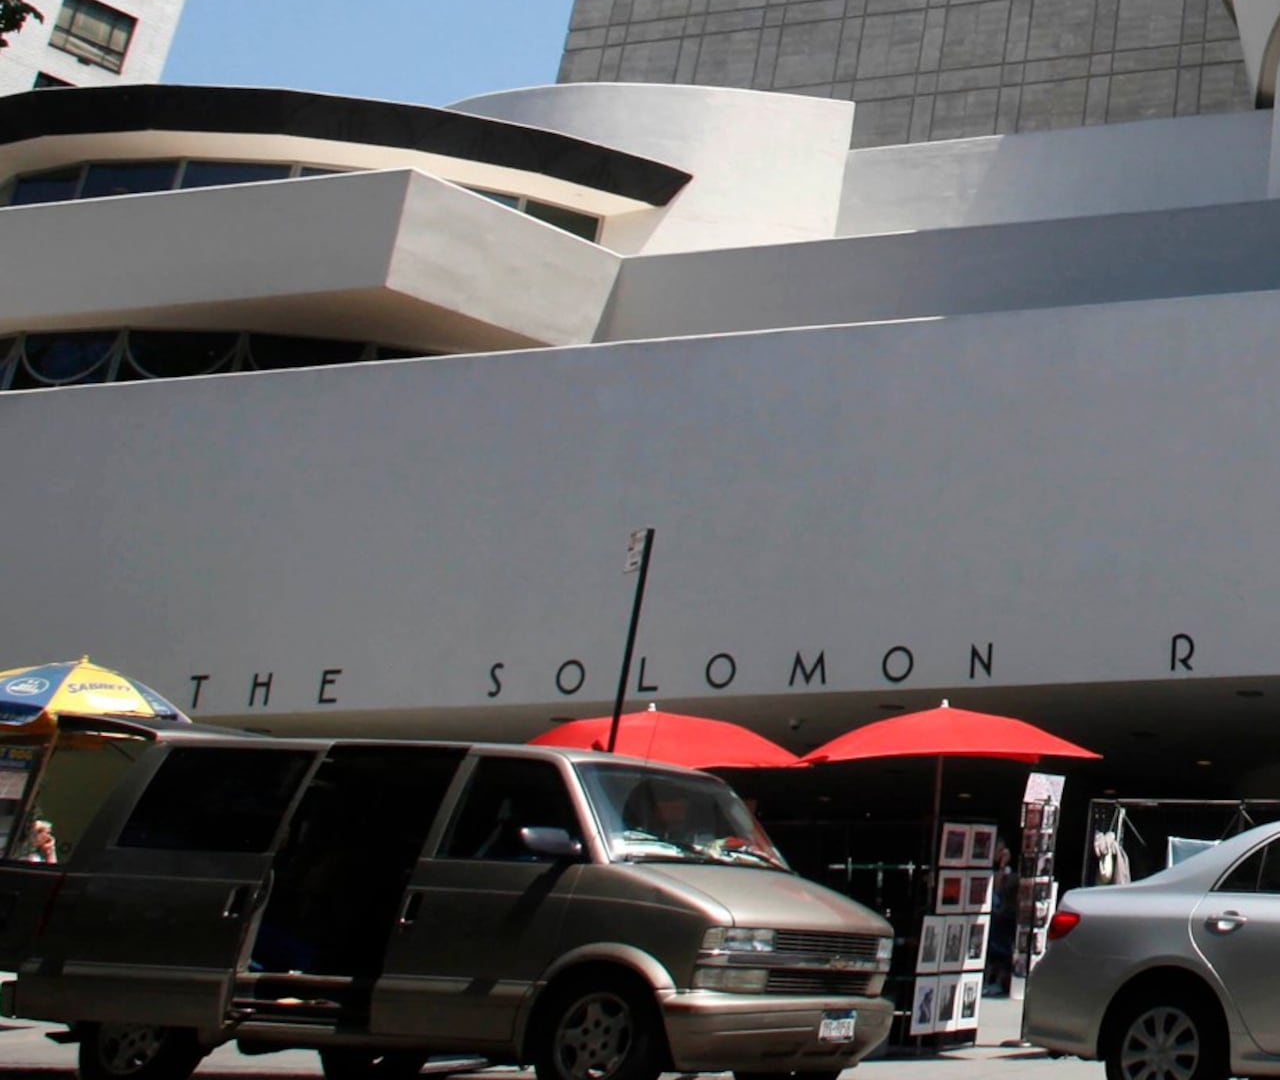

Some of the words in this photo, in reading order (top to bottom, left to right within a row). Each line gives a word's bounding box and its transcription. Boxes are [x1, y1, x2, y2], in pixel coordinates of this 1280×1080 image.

[189, 668, 343, 709] THE
[487, 641, 993, 699] SOLOMON
[1170, 633, 1195, 672] R
